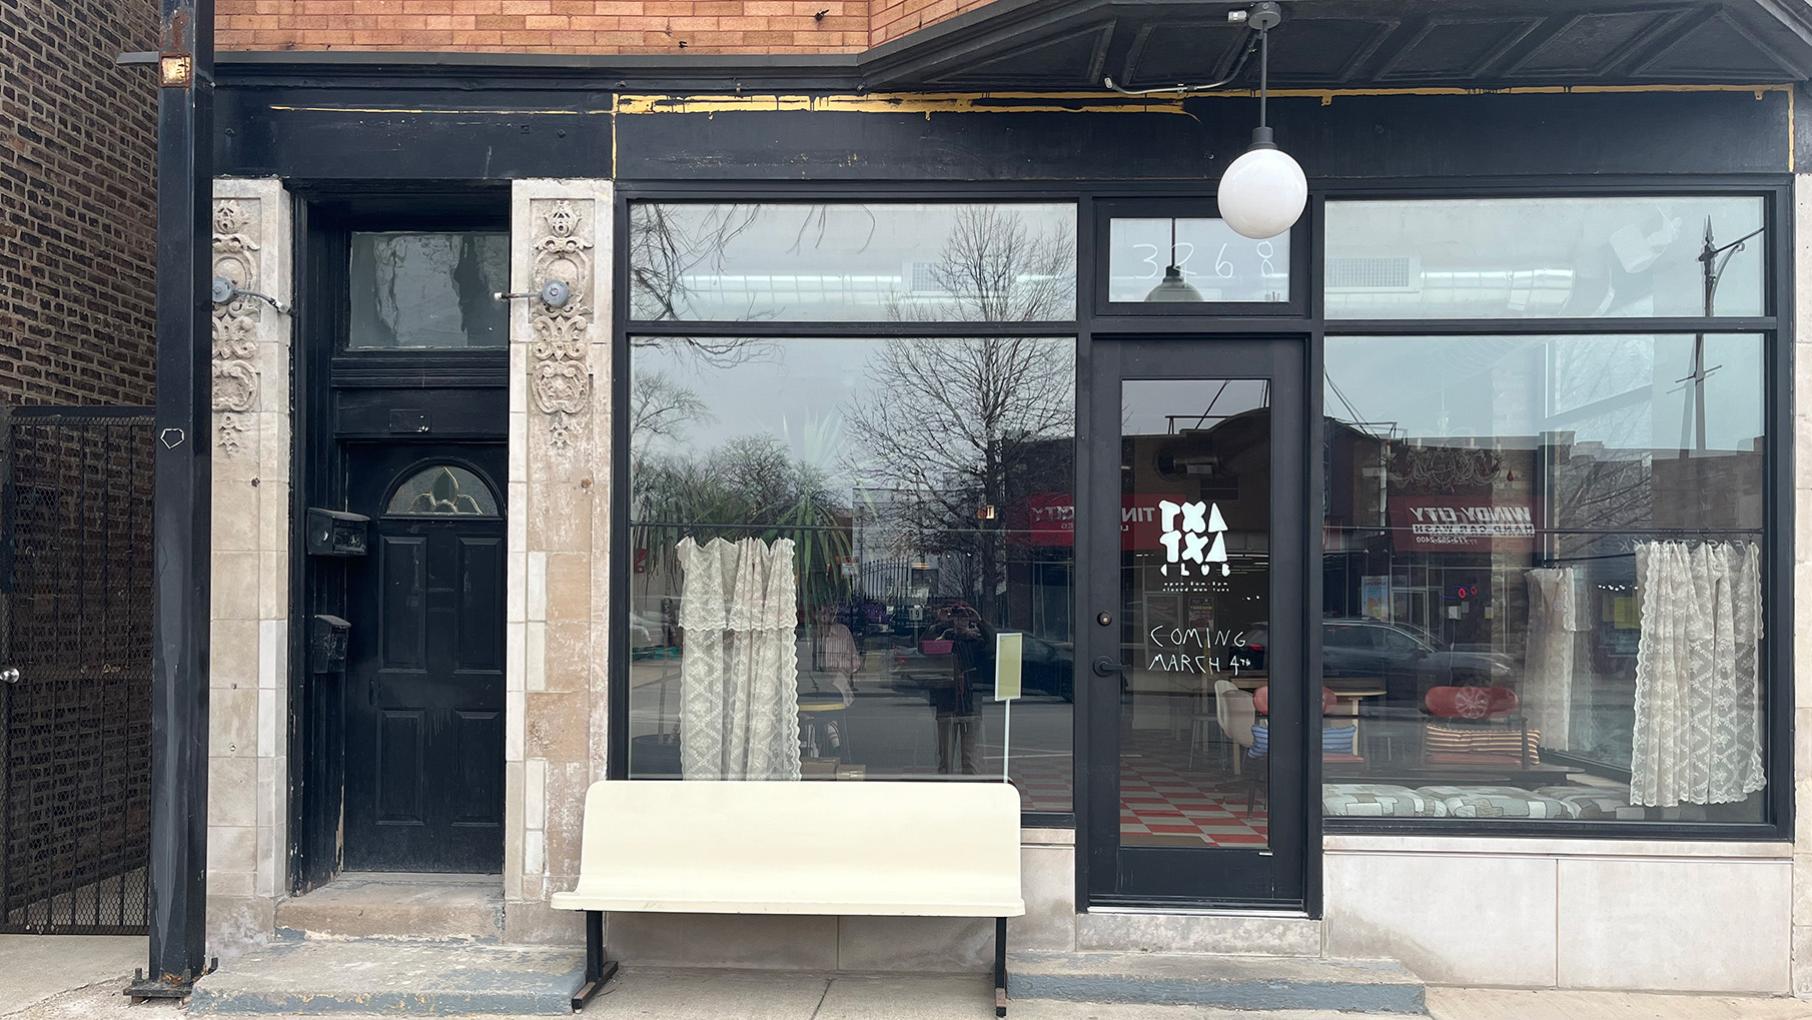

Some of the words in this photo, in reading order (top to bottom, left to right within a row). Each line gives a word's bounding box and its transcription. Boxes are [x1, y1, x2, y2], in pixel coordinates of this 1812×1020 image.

[1132, 240, 1274, 280] 3268
[1150, 625, 1246, 648] COMING
[1148, 653, 1221, 675] MARCH
